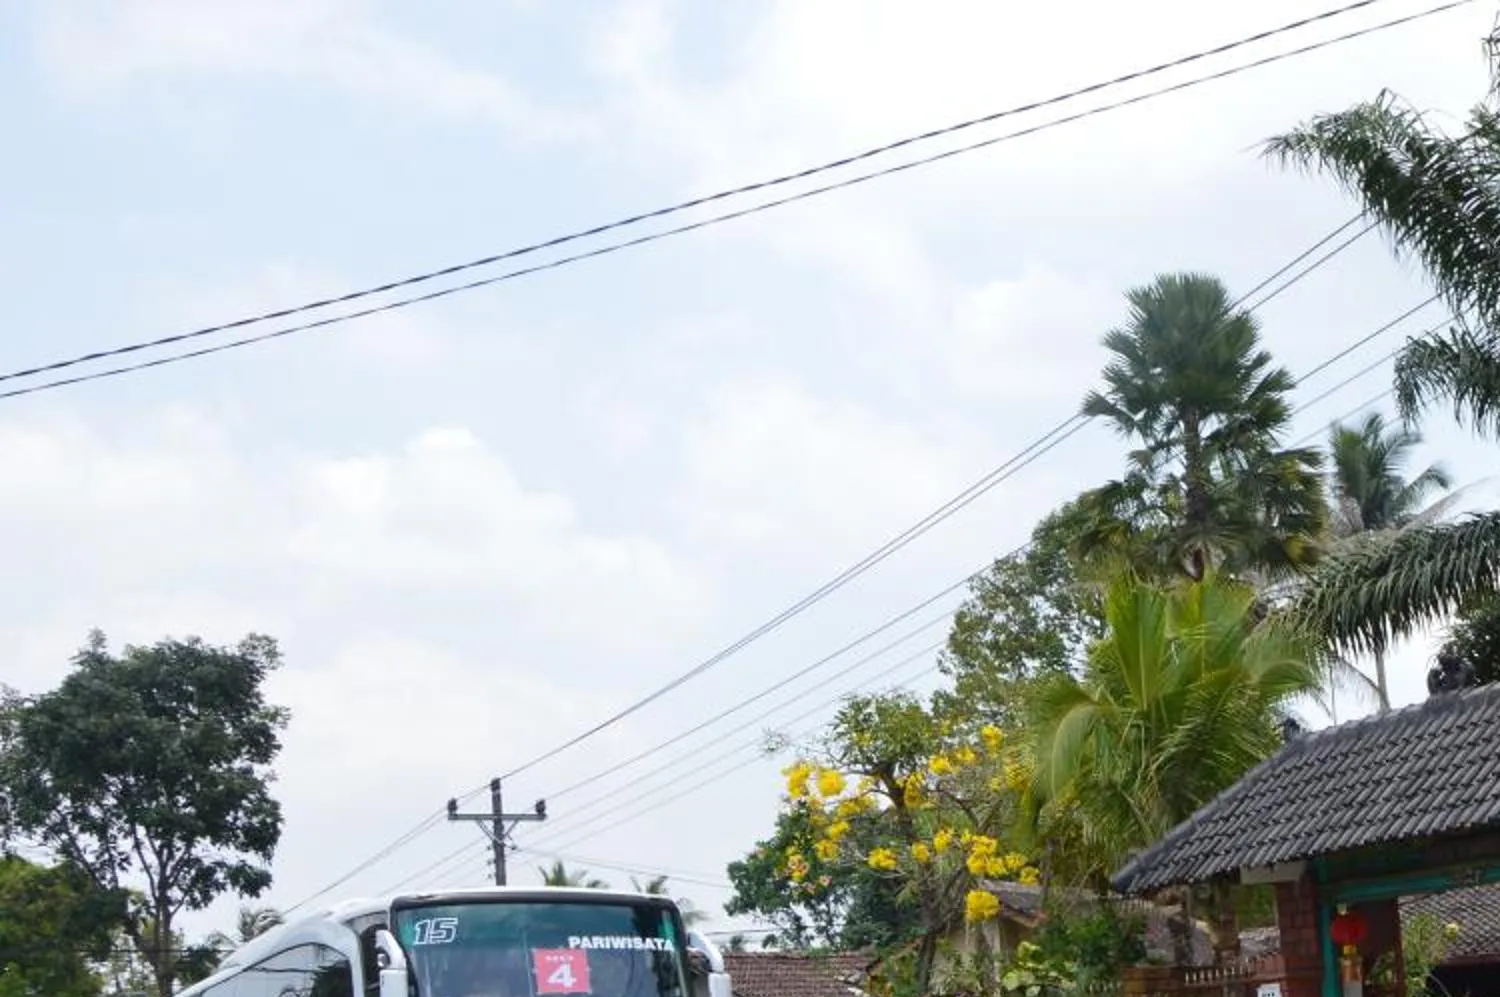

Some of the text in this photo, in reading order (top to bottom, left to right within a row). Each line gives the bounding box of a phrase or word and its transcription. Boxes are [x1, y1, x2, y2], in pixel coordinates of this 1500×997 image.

[414, 917, 459, 945] 15
[568, 935, 675, 951] PARIWISATA
[547, 963, 577, 988] 4
